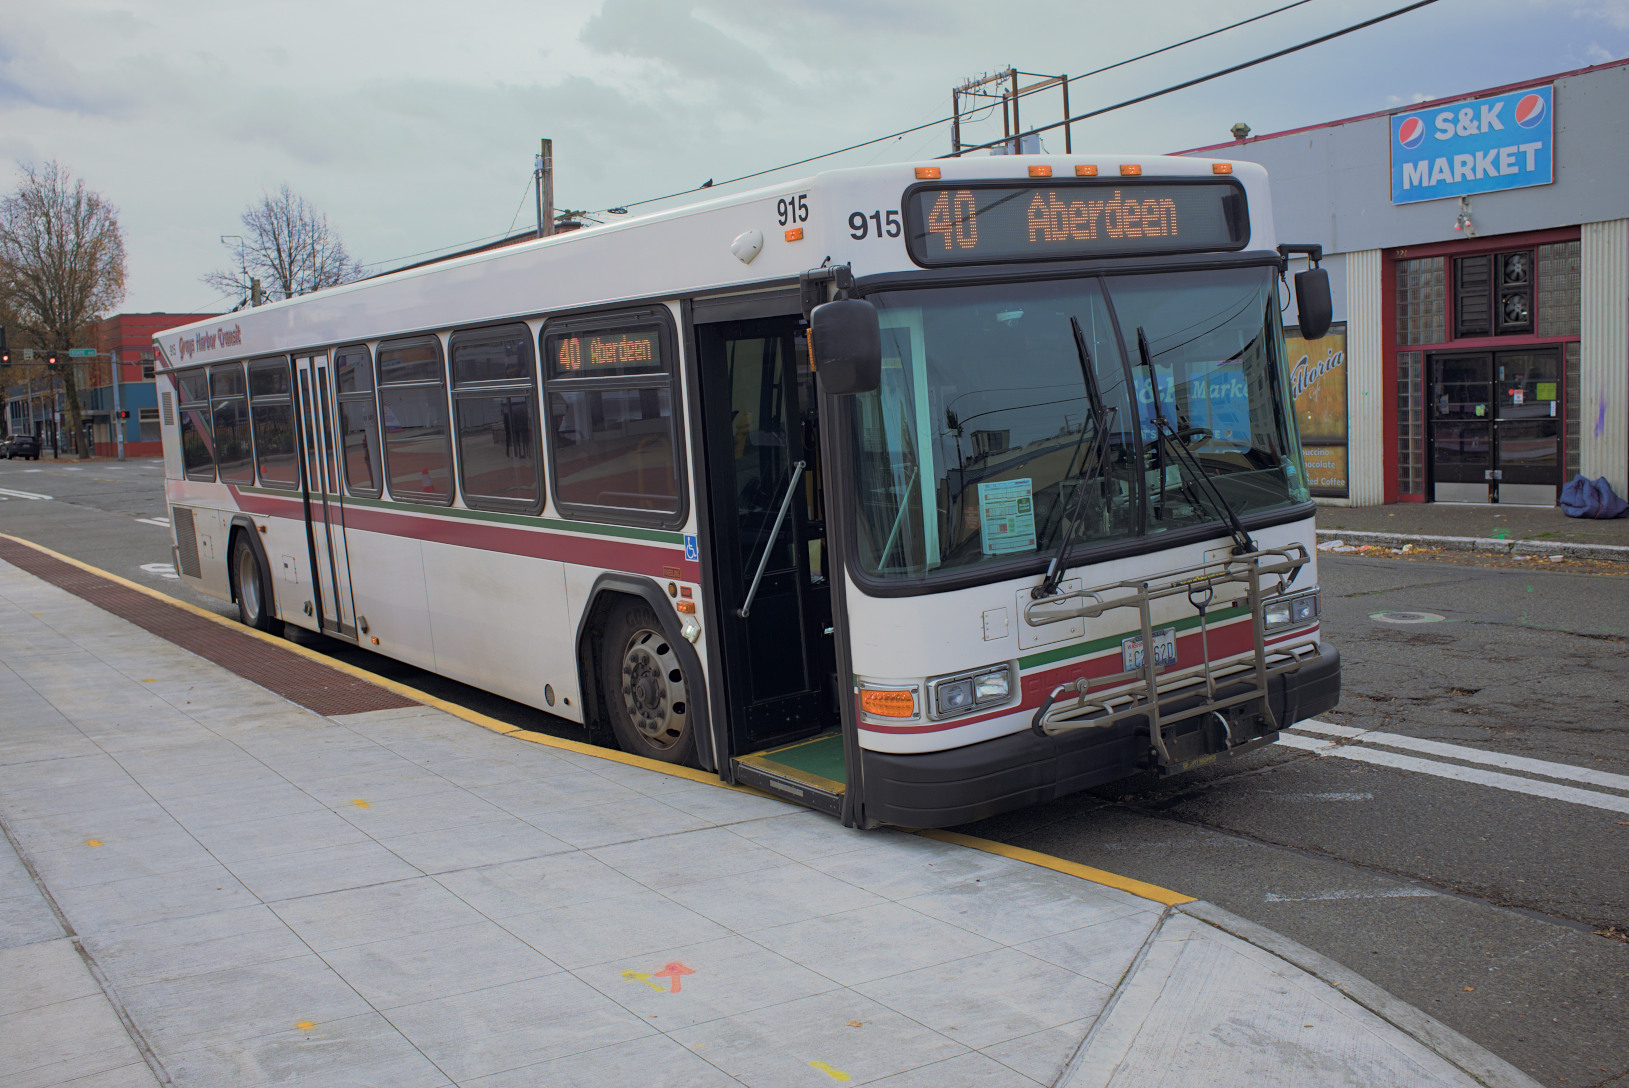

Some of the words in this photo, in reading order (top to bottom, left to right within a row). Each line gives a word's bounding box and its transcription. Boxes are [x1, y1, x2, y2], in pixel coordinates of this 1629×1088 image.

[1434, 101, 1505, 141] S&K
[1402, 141, 1543, 190] MARKET
[777, 193, 809, 226] 915
[848, 209, 901, 241] 915
[928, 190, 978, 250] 40
[1027, 190, 1178, 242] Aberdeen
[196, 330, 217, 353] Harbor
[217, 323, 242, 348] Transit
[559, 337, 581, 370] 40
[590, 334, 652, 364] Aberdeen
[1320, 477, 1345, 486] Coffee
